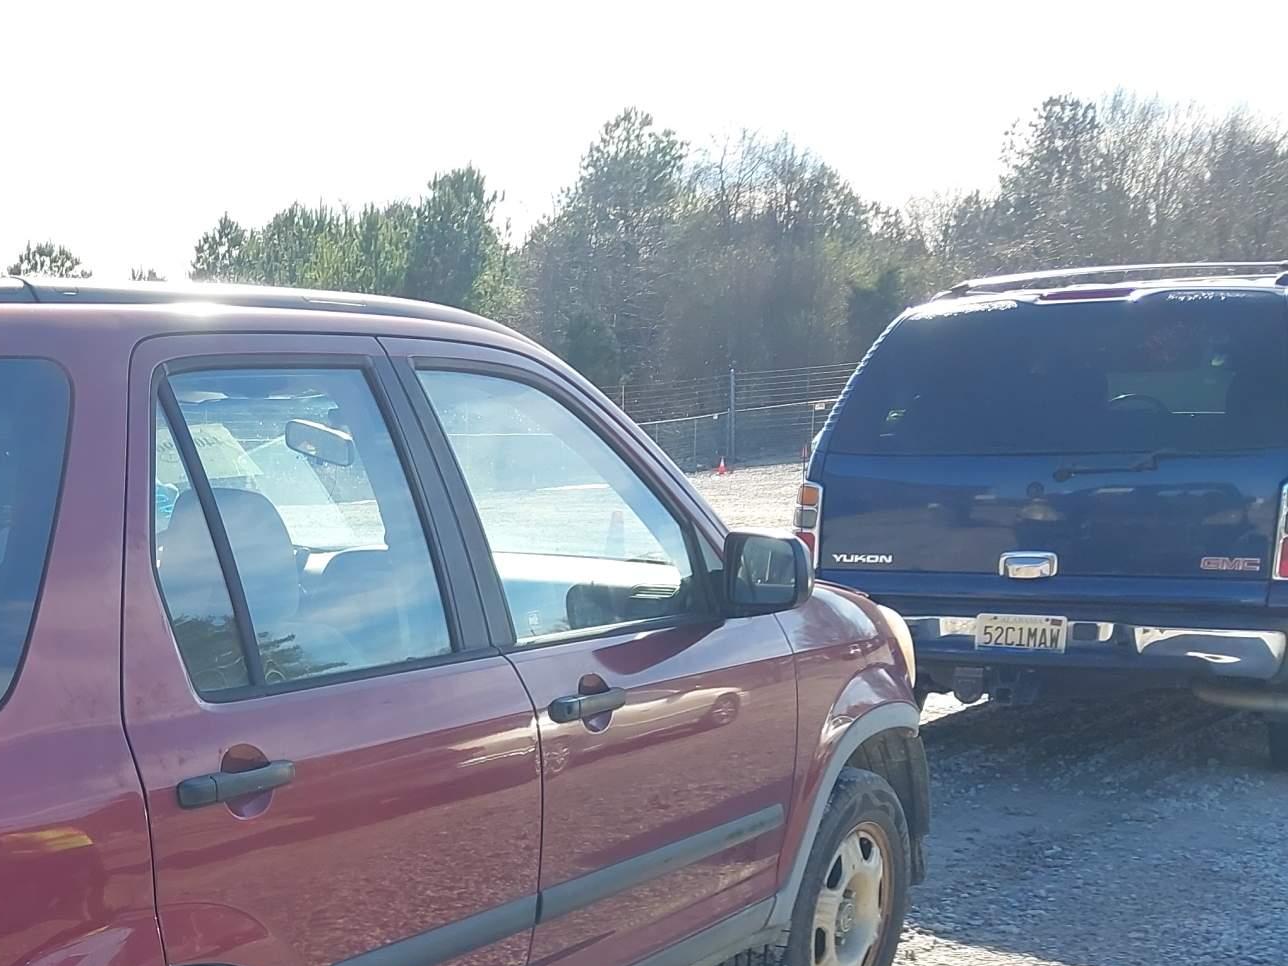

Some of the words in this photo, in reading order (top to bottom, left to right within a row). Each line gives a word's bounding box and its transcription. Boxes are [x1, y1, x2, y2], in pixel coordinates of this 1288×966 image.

[832, 554, 893, 563] YUKON
[1200, 556, 1261, 571] GMC
[983, 625, 1061, 649] 52C1MAW
